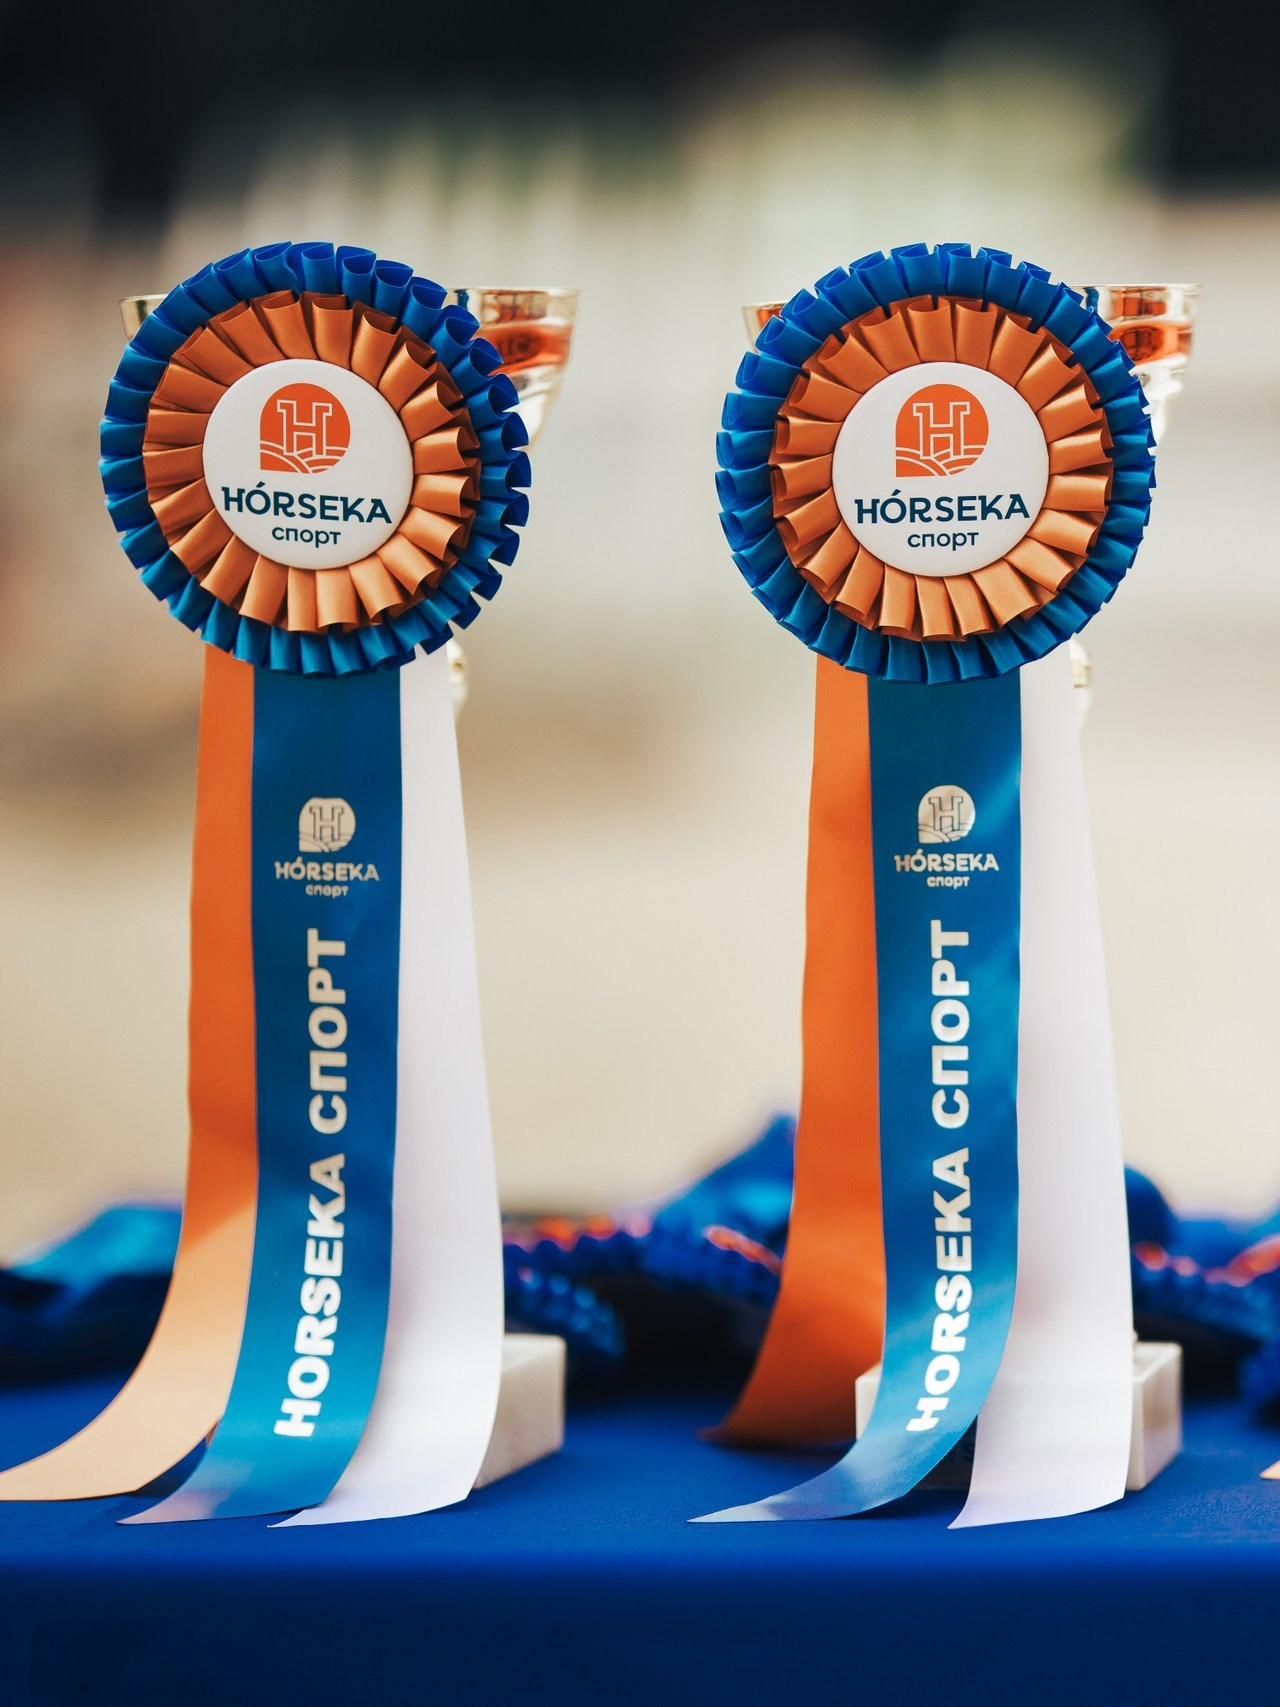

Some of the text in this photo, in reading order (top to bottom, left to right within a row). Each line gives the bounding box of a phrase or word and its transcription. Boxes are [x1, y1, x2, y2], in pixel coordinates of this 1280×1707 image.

[221, 481, 392, 525] HÓRSEKA
[854, 489, 1030, 524] HÓRSEKA
[271, 526, 341, 548] спорт
[907, 531, 979, 551] спорт
[274, 856, 379, 881] HÓRSEKA
[894, 848, 999, 872] HÓRSEKA
[305, 884, 349, 899] спорт
[926, 876, 970, 889] спорт
[273, 928, 347, 1437] HORSEKA СПОРТ
[905, 919, 973, 1432] HORSEKA СПОРТ
